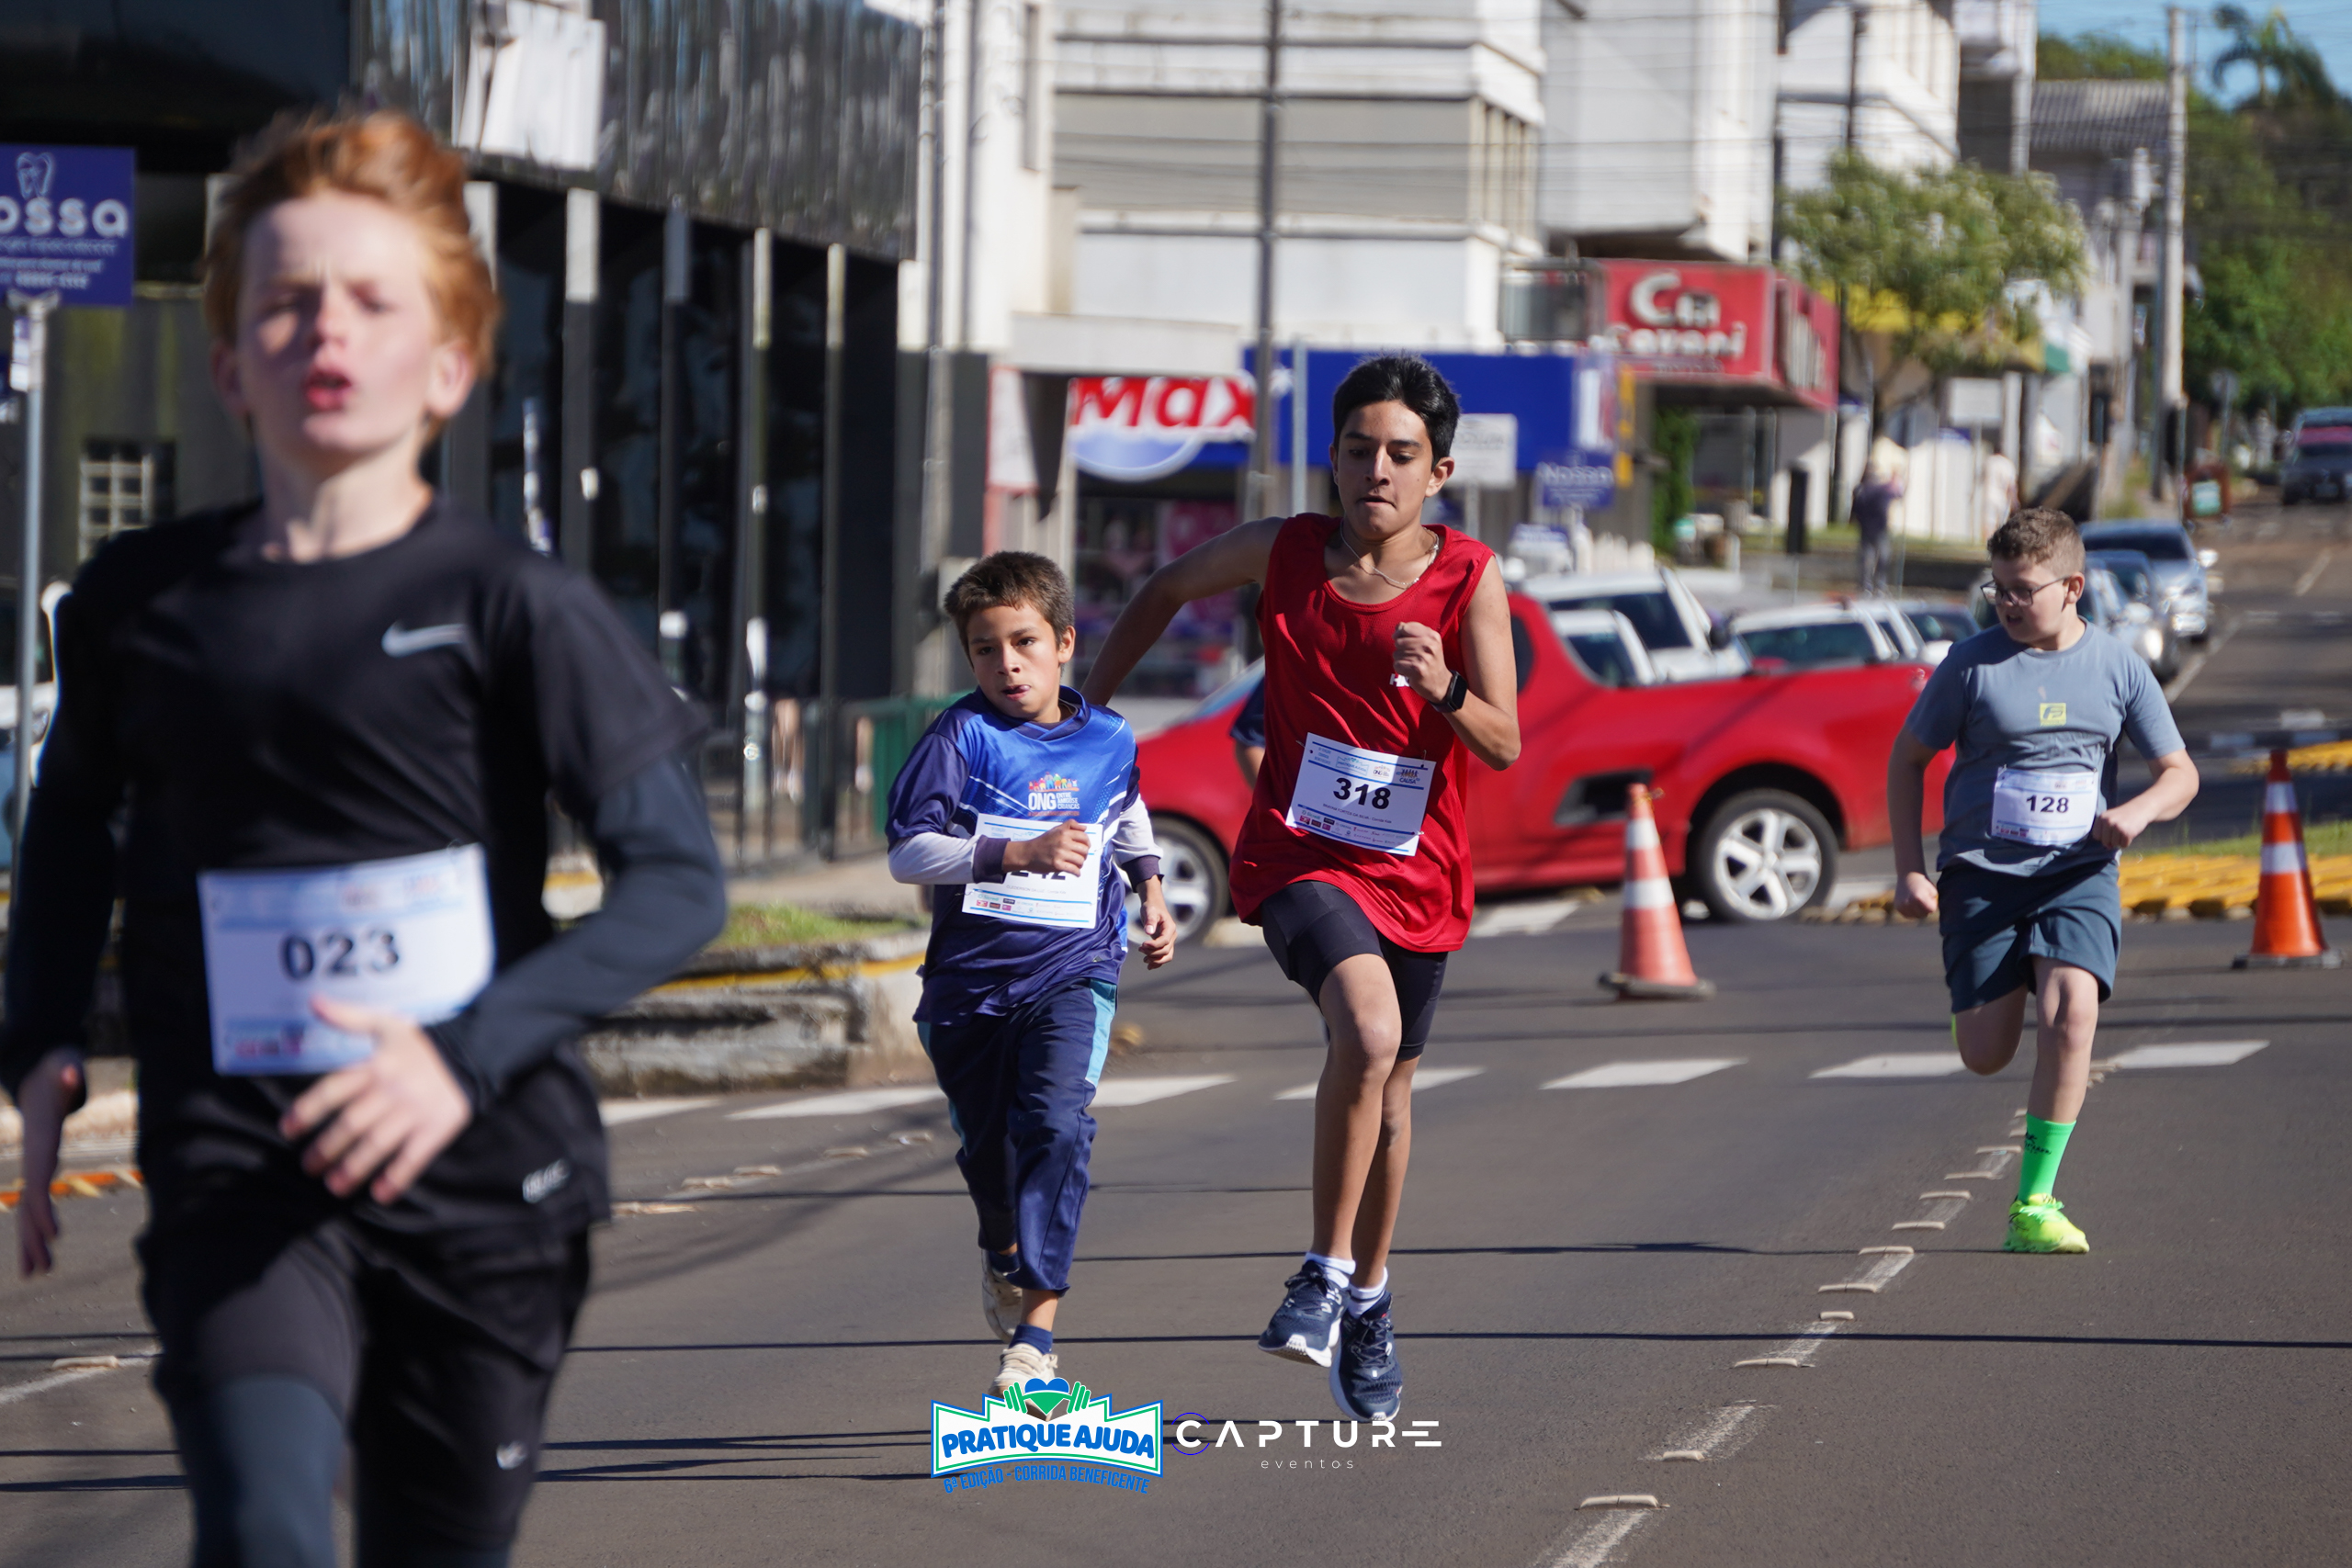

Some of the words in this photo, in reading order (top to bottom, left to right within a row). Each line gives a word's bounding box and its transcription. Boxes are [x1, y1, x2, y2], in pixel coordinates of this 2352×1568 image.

[1028, 792, 1057, 810] ONG
[1333, 777, 1391, 810] 318
[2026, 795, 2069, 813] 128
[281, 929, 400, 982] 023
